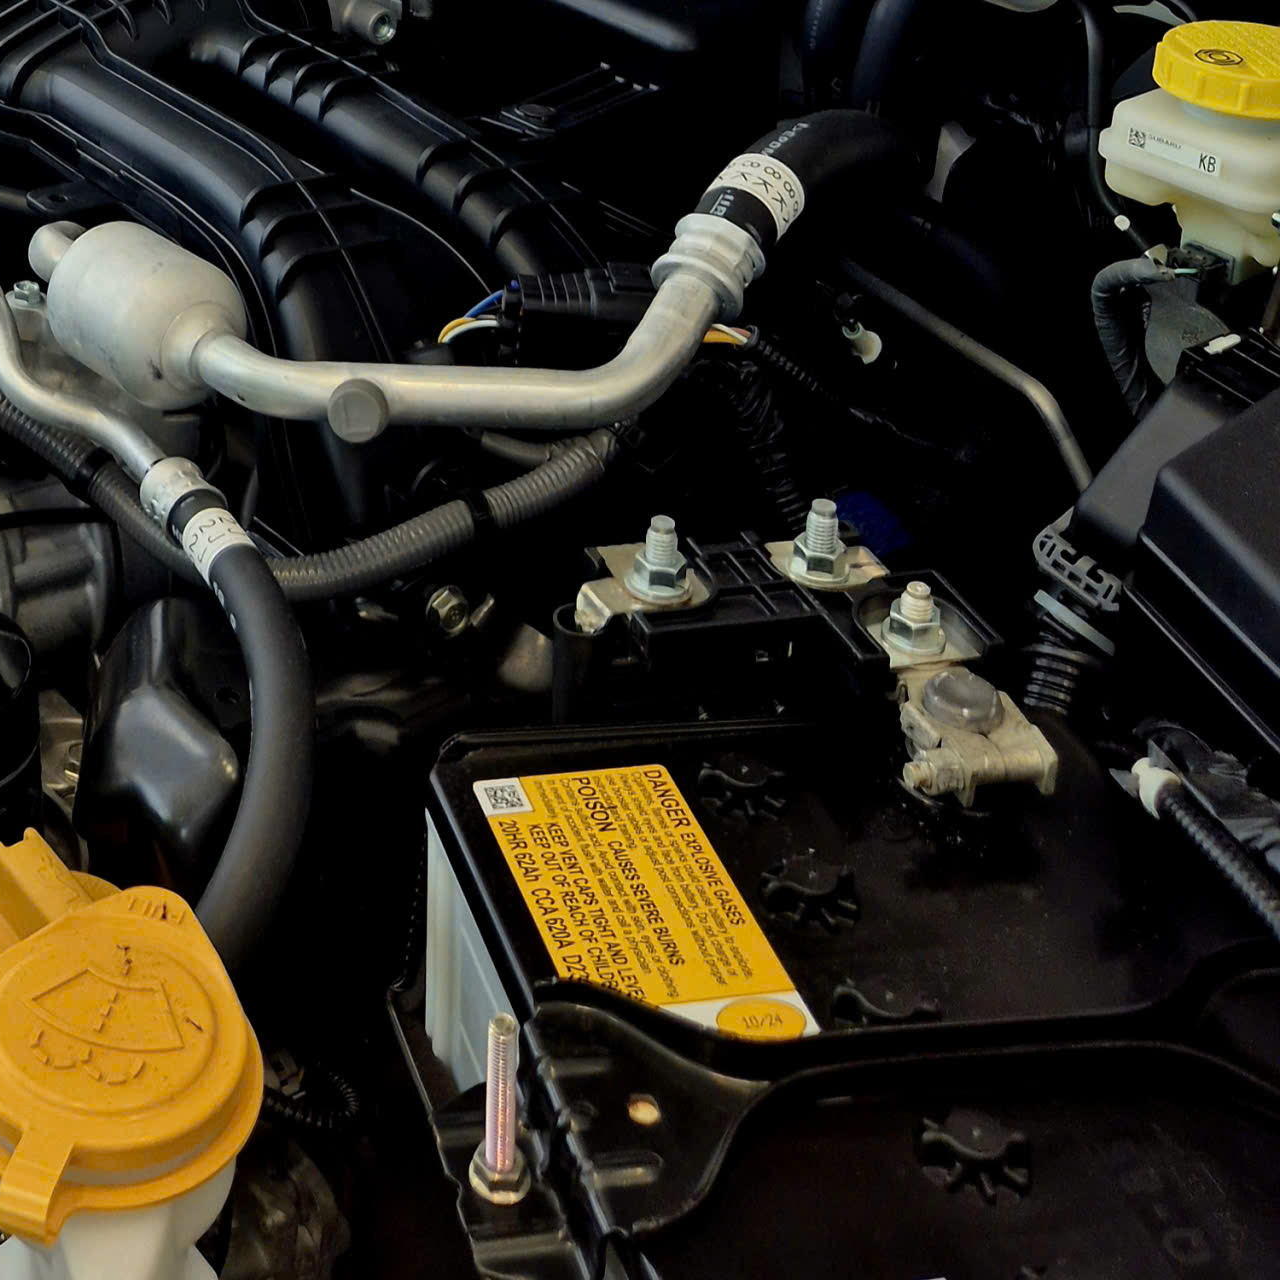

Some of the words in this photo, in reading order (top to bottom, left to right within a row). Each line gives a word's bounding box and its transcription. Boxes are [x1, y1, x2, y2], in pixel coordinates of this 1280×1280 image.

[1198, 152, 1217, 174] KB
[497, 819, 528, 851] 20HR
[527, 823, 551, 849] KEEP
[642, 769, 691, 828] DANGER
[679, 831, 723, 887] EXPLOSIVE
[712, 888, 746, 926] GASES
[513, 852, 541, 882] 62Ah
[539, 850, 563, 871] OUT
[571, 776, 616, 832] POISON
[606, 839, 640, 881] CAUSES
[629, 882, 664, 924] SEVERE
[652, 926, 685, 966] BURNS
[546, 821, 570, 847] KEEP
[559, 848, 584, 875] VENT
[572, 876, 599, 906] CAPS
[588, 906, 616, 938] TIGHT
[605, 941, 628, 965] AND
[550, 873, 571, 888] OF
[530, 887, 559, 916] CCA
[559, 890, 589, 927] REACH
[544, 917, 575, 949] 620A
[577, 928, 599, 943] OF
[740, 1011, 785, 1032] 10/24
